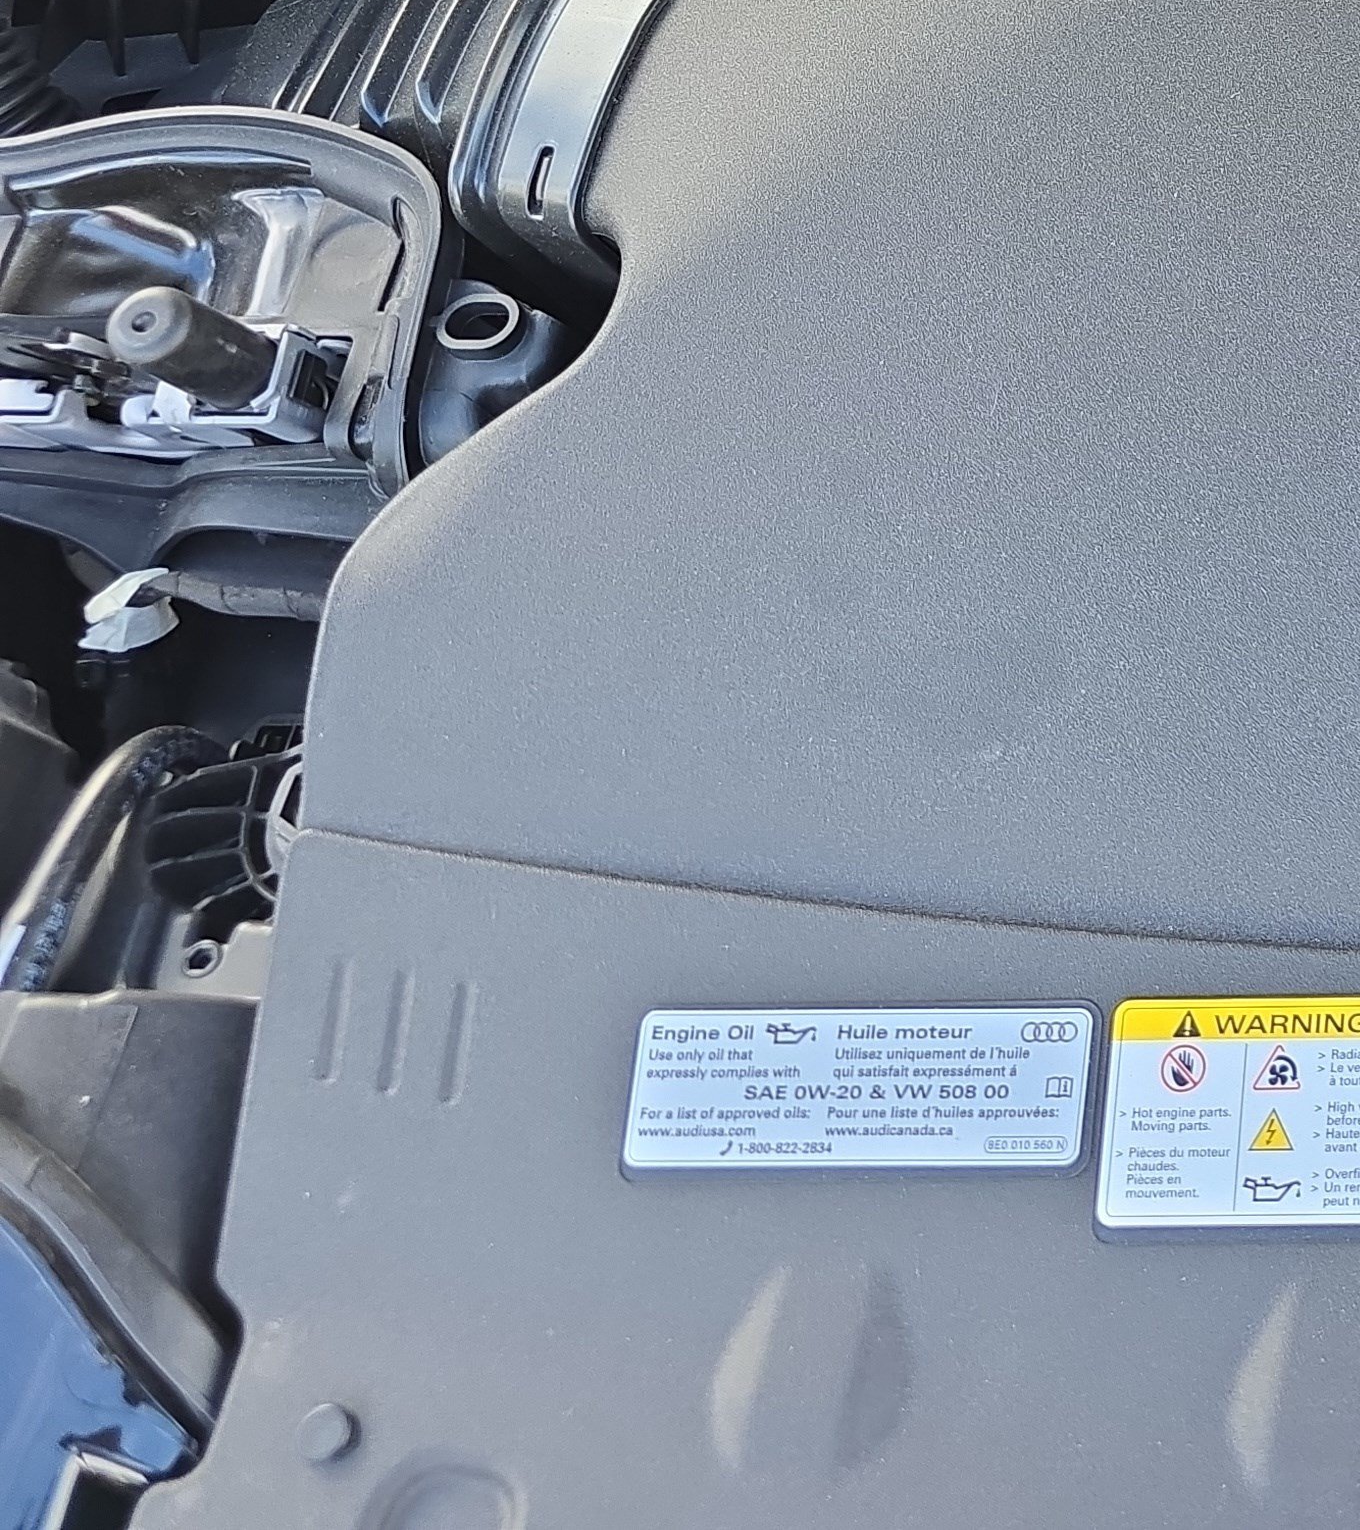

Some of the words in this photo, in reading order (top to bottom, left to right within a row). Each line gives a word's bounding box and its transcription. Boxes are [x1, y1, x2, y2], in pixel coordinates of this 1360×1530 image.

[651, 1025, 721, 1044] Engine
[727, 1024, 755, 1041] Oil
[837, 1024, 889, 1040] Huile
[894, 1025, 973, 1040] moteur
[648, 1048, 674, 1061] Use
[676, 1048, 705, 1064] only
[707, 1047, 725, 1062] oil
[727, 1047, 754, 1062] that
[834, 1047, 883, 1061] Utilisez
[886, 1046, 967, 1063] uniquement
[969, 1046, 986, 1060] de
[646, 1065, 708, 1081] expressly
[710, 1065, 770, 1081] complies
[772, 1064, 801, 1079] with
[832, 1064, 855, 1081] qui
[857, 1064, 910, 1078] satisfait
[912, 1063, 1007, 1080] expressément
[1329, 1061, 1345, 1074] Le
[1328, 1074, 1337, 1087] à
[743, 1085, 788, 1101] SAE
[794, 1084, 863, 1101] 0W-20
[868, 1084, 886, 1100] &
[893, 1084, 933, 1100] VW
[938, 1084, 977, 1100] 508
[983, 1084, 1010, 1100] 00
[639, 1106, 663, 1120] For
[664, 1110, 674, 1120] a
[676, 1106, 698, 1120] list
[699, 1106, 715, 1120] of
[716, 1106, 781, 1122] approved
[783, 1105, 812, 1120] oils:
[826, 1105, 859, 1119] Pour
[861, 1109, 887, 1119] une
[890, 1105, 918, 1119] liste
[977, 1105, 1060, 1121] approuvées:
[1131, 1107, 1153, 1119] Hot
[1155, 1107, 1197, 1121] engine
[1198, 1107, 1232, 1120] parts.
[1327, 1101, 1355, 1115] High
[637, 1124, 756, 1138] www.audiusa.com
[824, 1123, 954, 1137] www.audicanada.ca
[1130, 1119, 1176, 1134] Moving
[1178, 1121, 1212, 1134] parts.
[1325, 1127, 1360, 1140] Haute
[737, 1141, 833, 1155] 1-800-822-2834
[1010, 1139, 1031, 1150] 010
[1033, 1139, 1054, 1150] 560
[1324, 1142, 1358, 1153] avant
[1128, 1146, 1166, 1159] Pièces
[1168, 1146, 1185, 1158] du
[1187, 1148, 1232, 1158] moteur
[1127, 1160, 1180, 1172] chaudes.
[1126, 1173, 1164, 1185] Pièces
[1166, 1176, 1182, 1185] en
[1125, 1188, 1200, 1199] mouvement.
[1323, 1181, 1342, 1193] Un
[1322, 1196, 1350, 1209] peut
